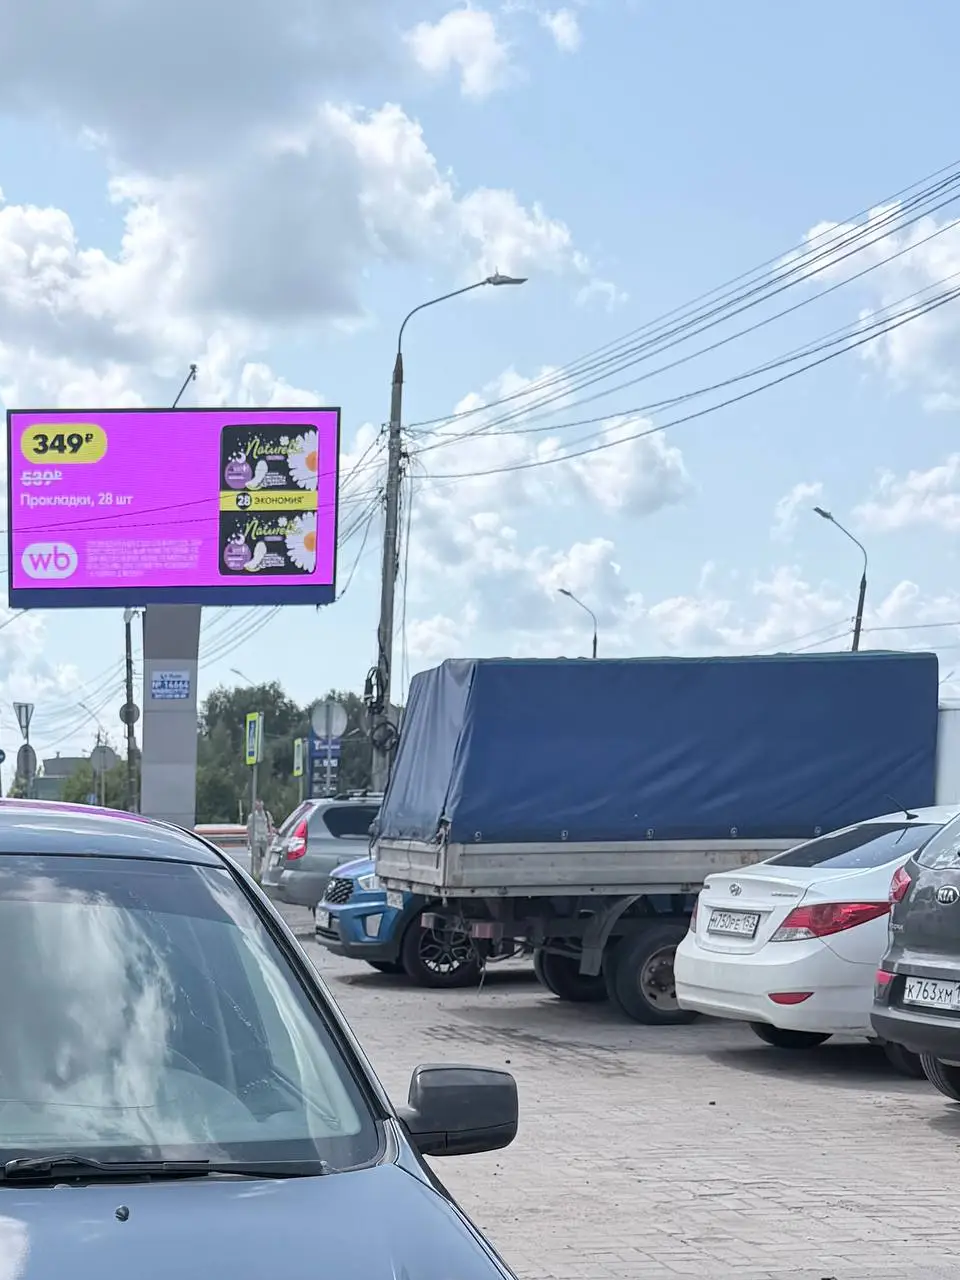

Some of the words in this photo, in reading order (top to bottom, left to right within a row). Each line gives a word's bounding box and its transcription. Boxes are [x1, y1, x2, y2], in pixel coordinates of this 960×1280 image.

[21, 493, 95, 508] Прокладки,
[98, 493, 113, 506] 28
[116, 496, 134, 506] шт
[237, 494, 251, 506] 28
[28, 545, 71, 572] wb
[937, 888, 954, 902] KIA
